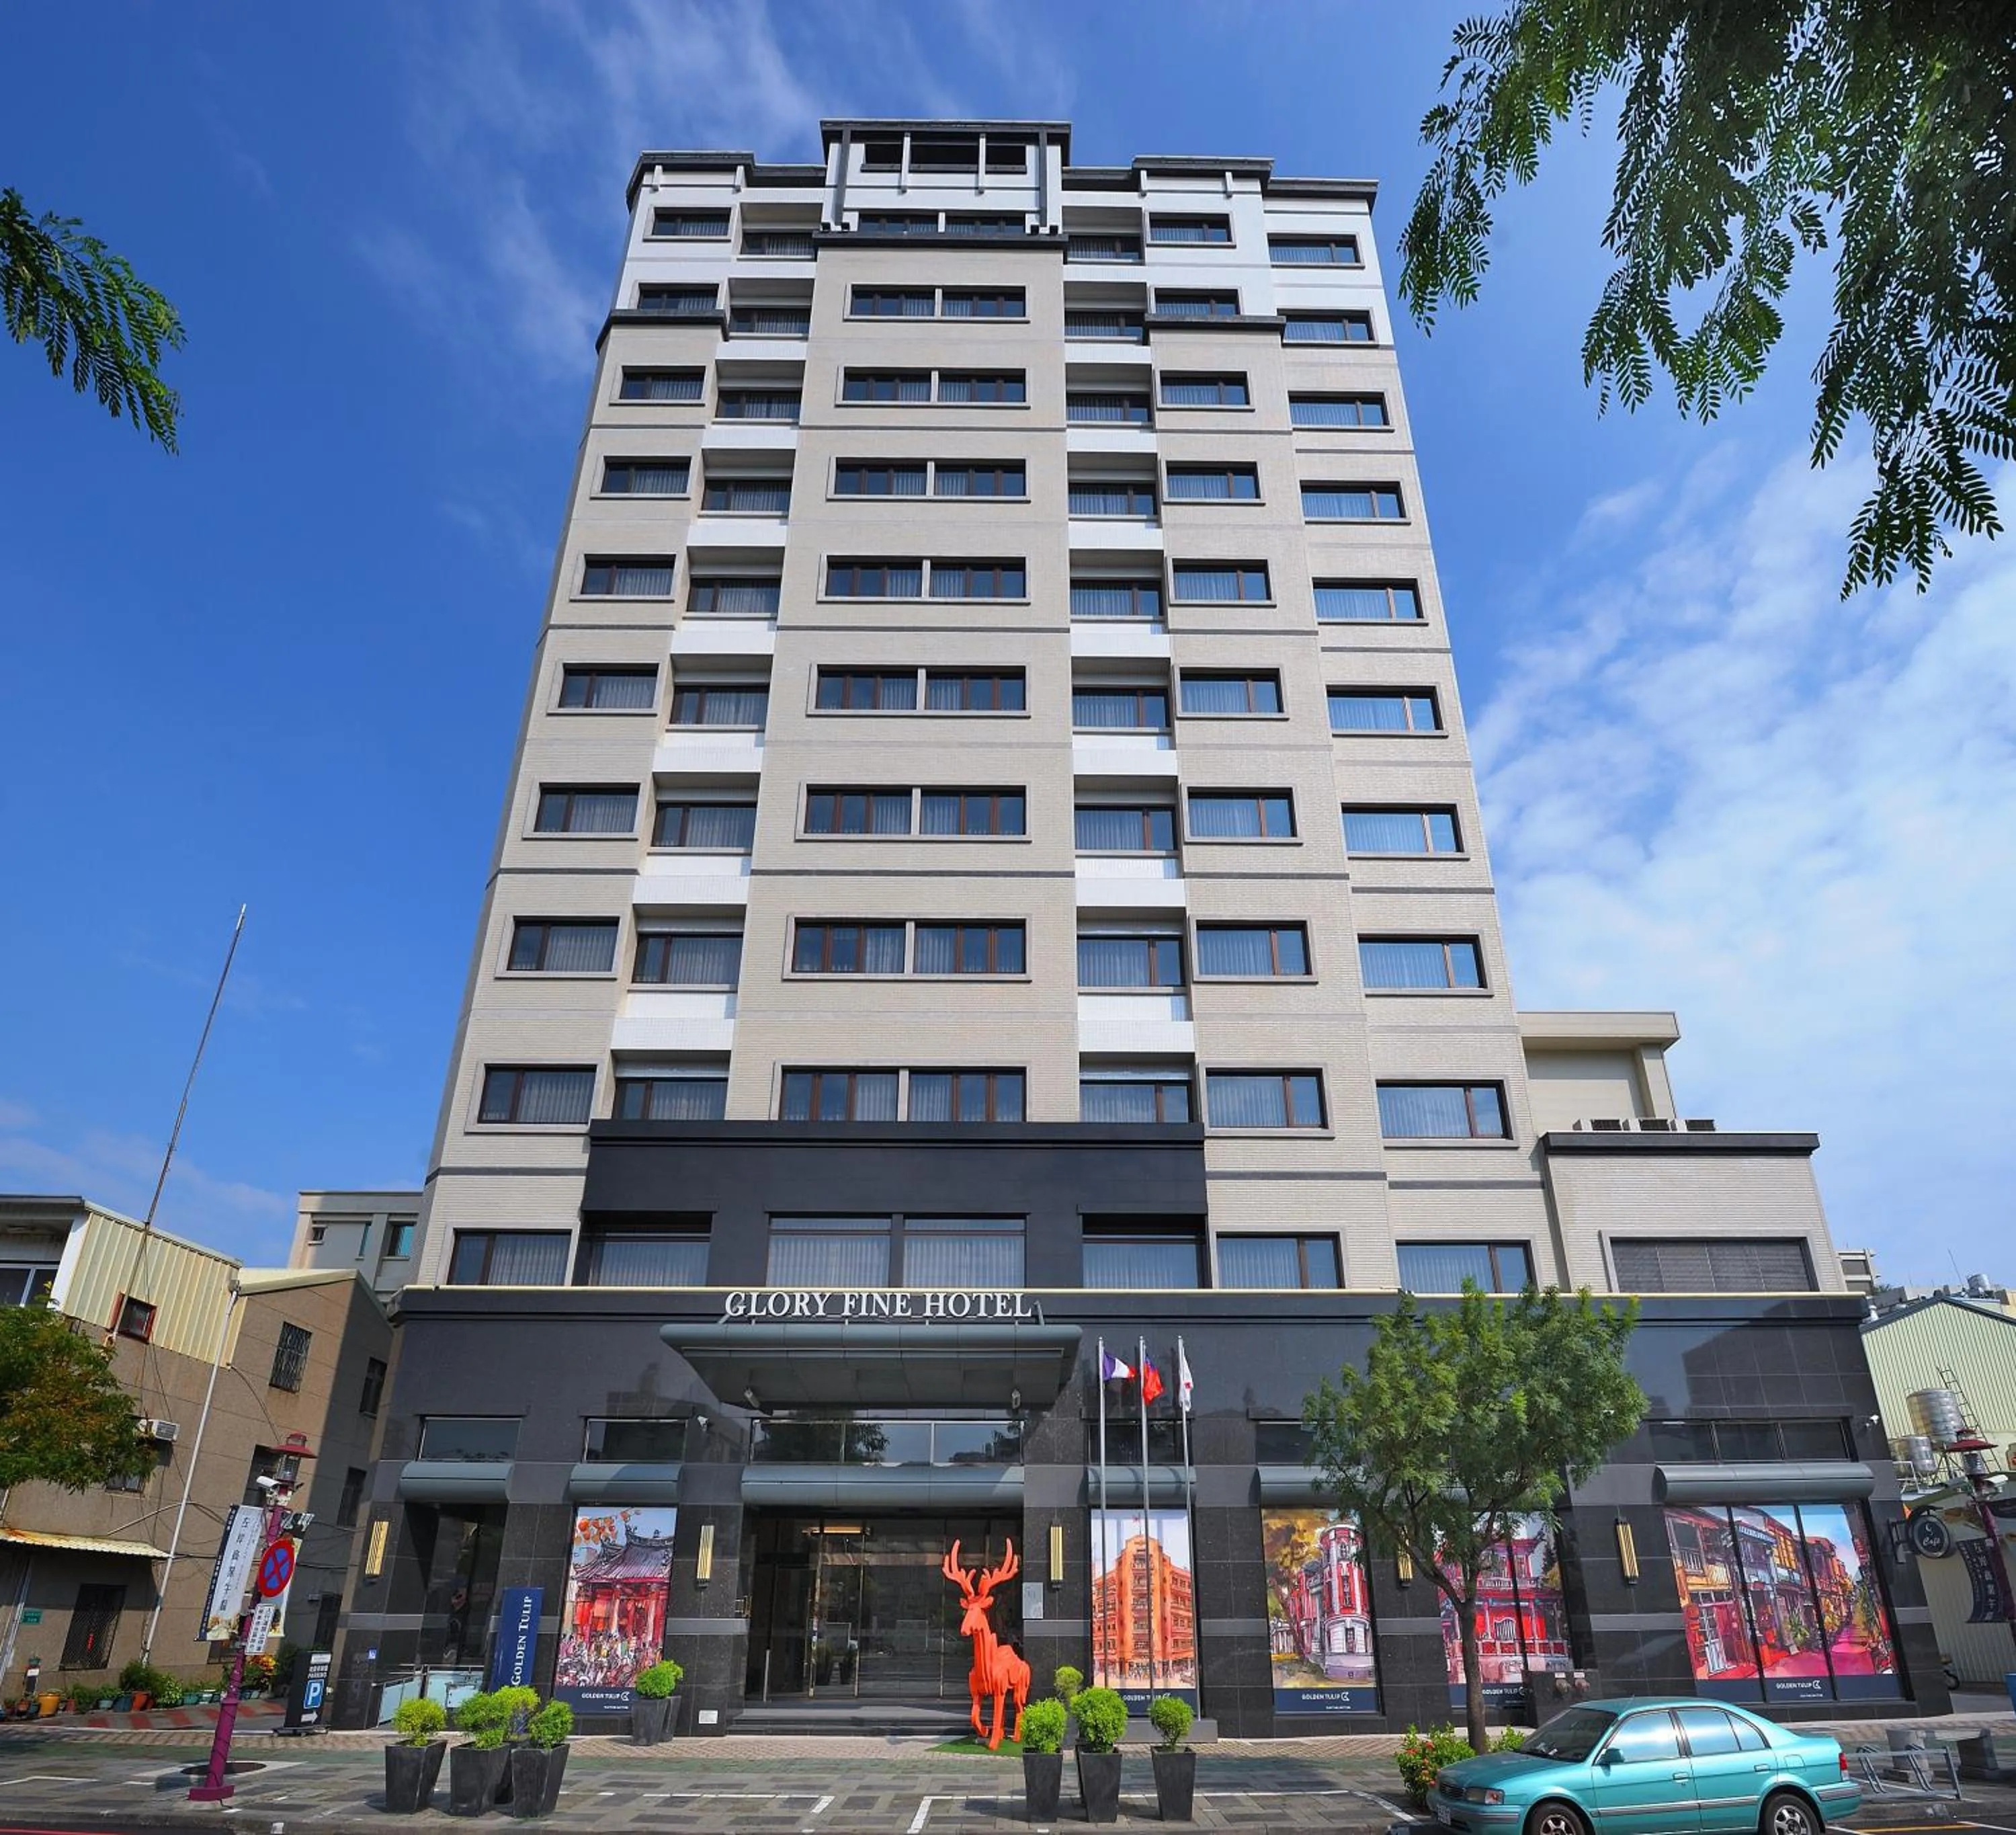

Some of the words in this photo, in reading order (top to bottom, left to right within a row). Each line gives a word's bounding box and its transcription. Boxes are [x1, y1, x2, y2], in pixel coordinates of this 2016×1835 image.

[724, 1292, 831, 1318] GLORY
[843, 1292, 913, 1318] FINE
[924, 1292, 1032, 1318] HOTEL
[518, 1596, 533, 1631] TULIP
[511, 1635, 527, 1686] GOLDEN
